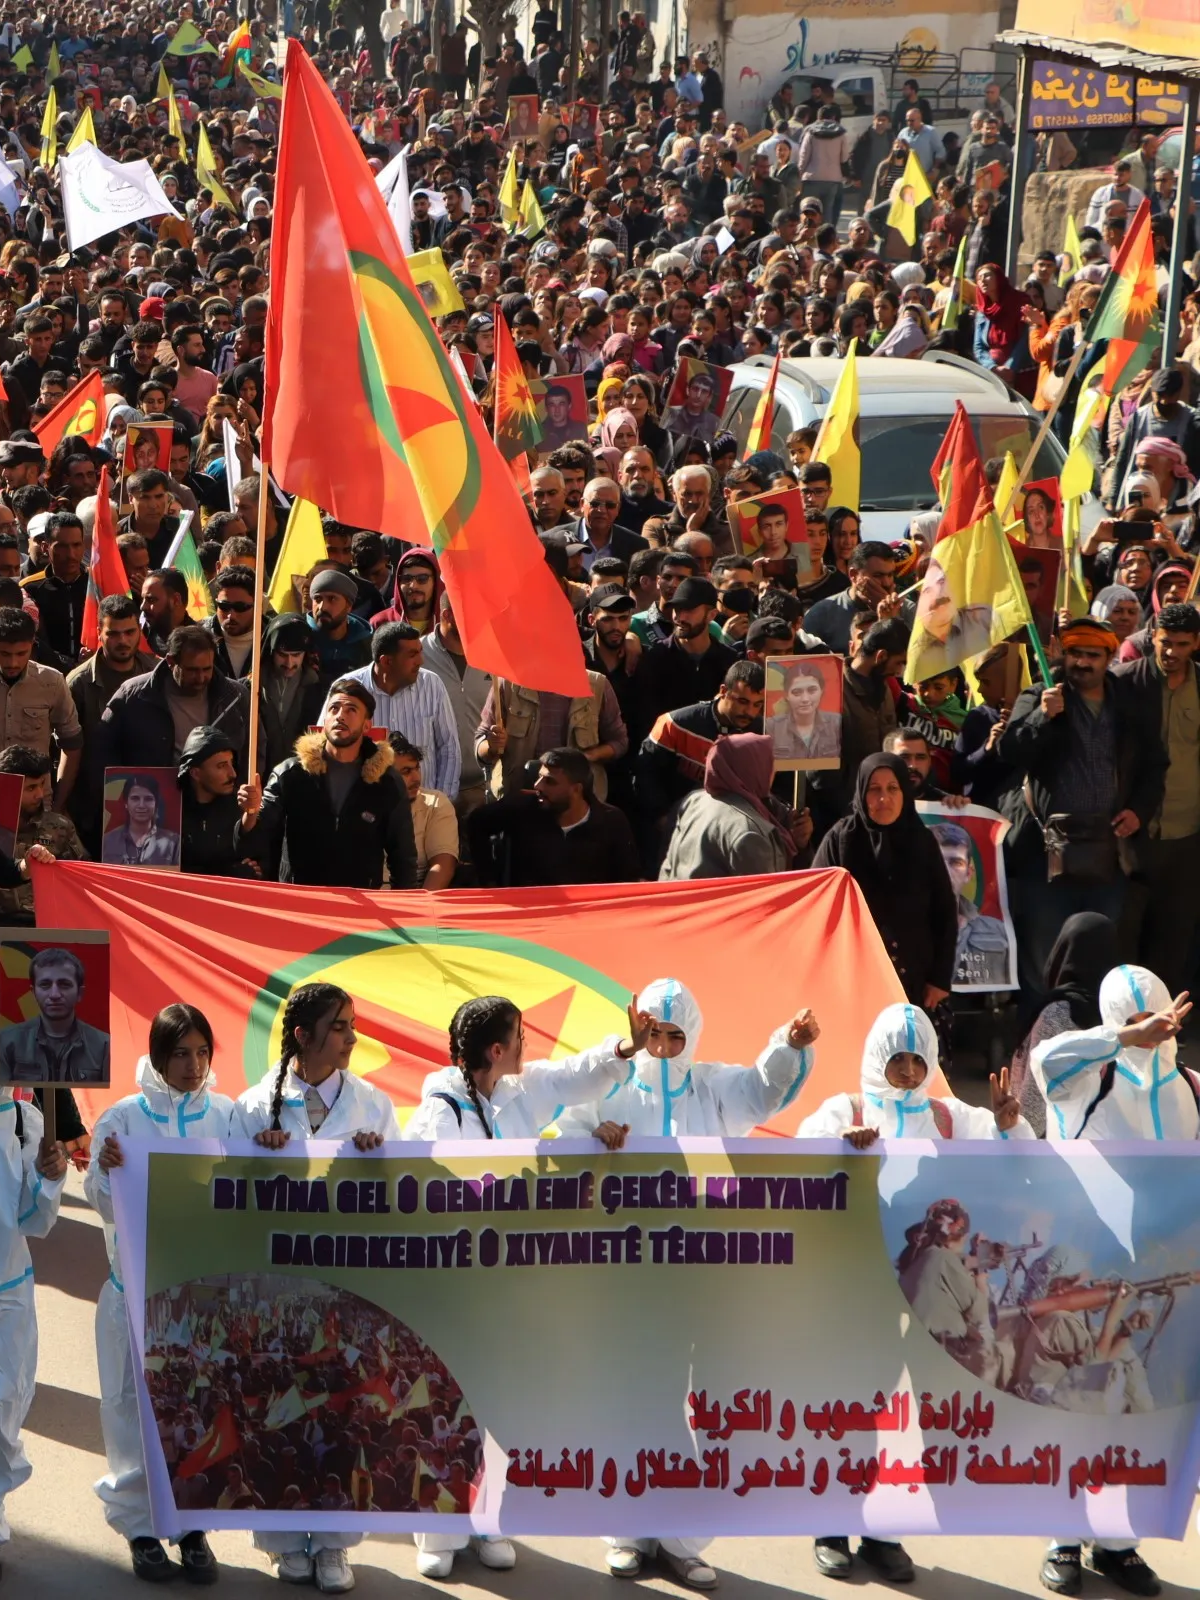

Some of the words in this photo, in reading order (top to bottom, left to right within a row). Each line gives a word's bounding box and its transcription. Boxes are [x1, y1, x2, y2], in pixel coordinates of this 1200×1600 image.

[214, 1178, 247, 1210] BI
[254, 1174, 329, 1213] VÎNA
[336, 1180, 391, 1213] GEL
[601, 1170, 697, 1214] ÇEKÊN
[506, 1225, 642, 1265] XIYANETÊ
[649, 1225, 794, 1265] TÊKBIBIN
[777, 1399, 796, 1441] و
[803, 1390, 909, 1441] الشعوب
[506, 1447, 593, 1497] الخيانة
[599, 1457, 617, 1498] و
[734, 1447, 805, 1497] ندحر
[810, 1456, 828, 1496] و
[836, 1445, 958, 1494] الكيماوية
[1068, 1445, 1166, 1499] سنقاوم
